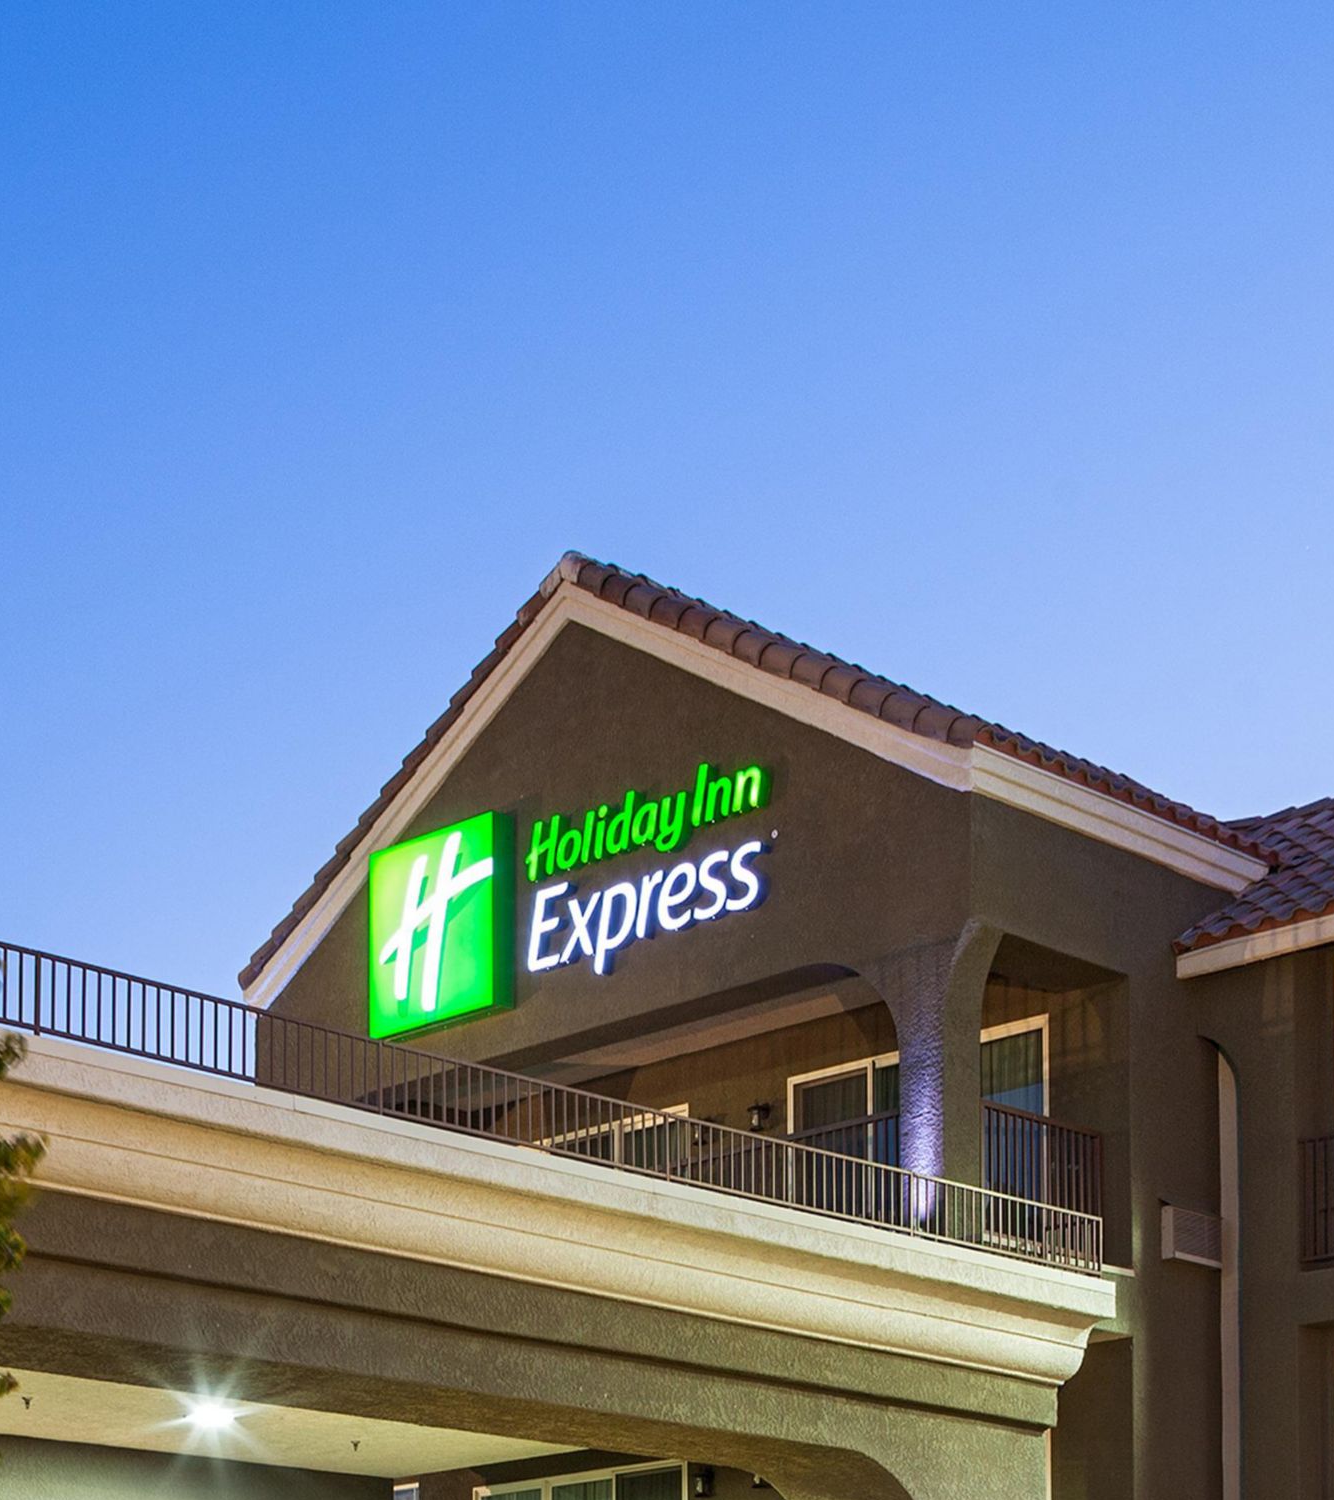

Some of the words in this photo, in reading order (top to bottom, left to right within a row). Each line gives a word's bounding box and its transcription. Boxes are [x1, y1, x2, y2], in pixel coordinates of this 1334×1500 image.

[524, 788, 688, 884] Holiday
[691, 763, 763, 827] Inn
[526, 840, 764, 976] Express
